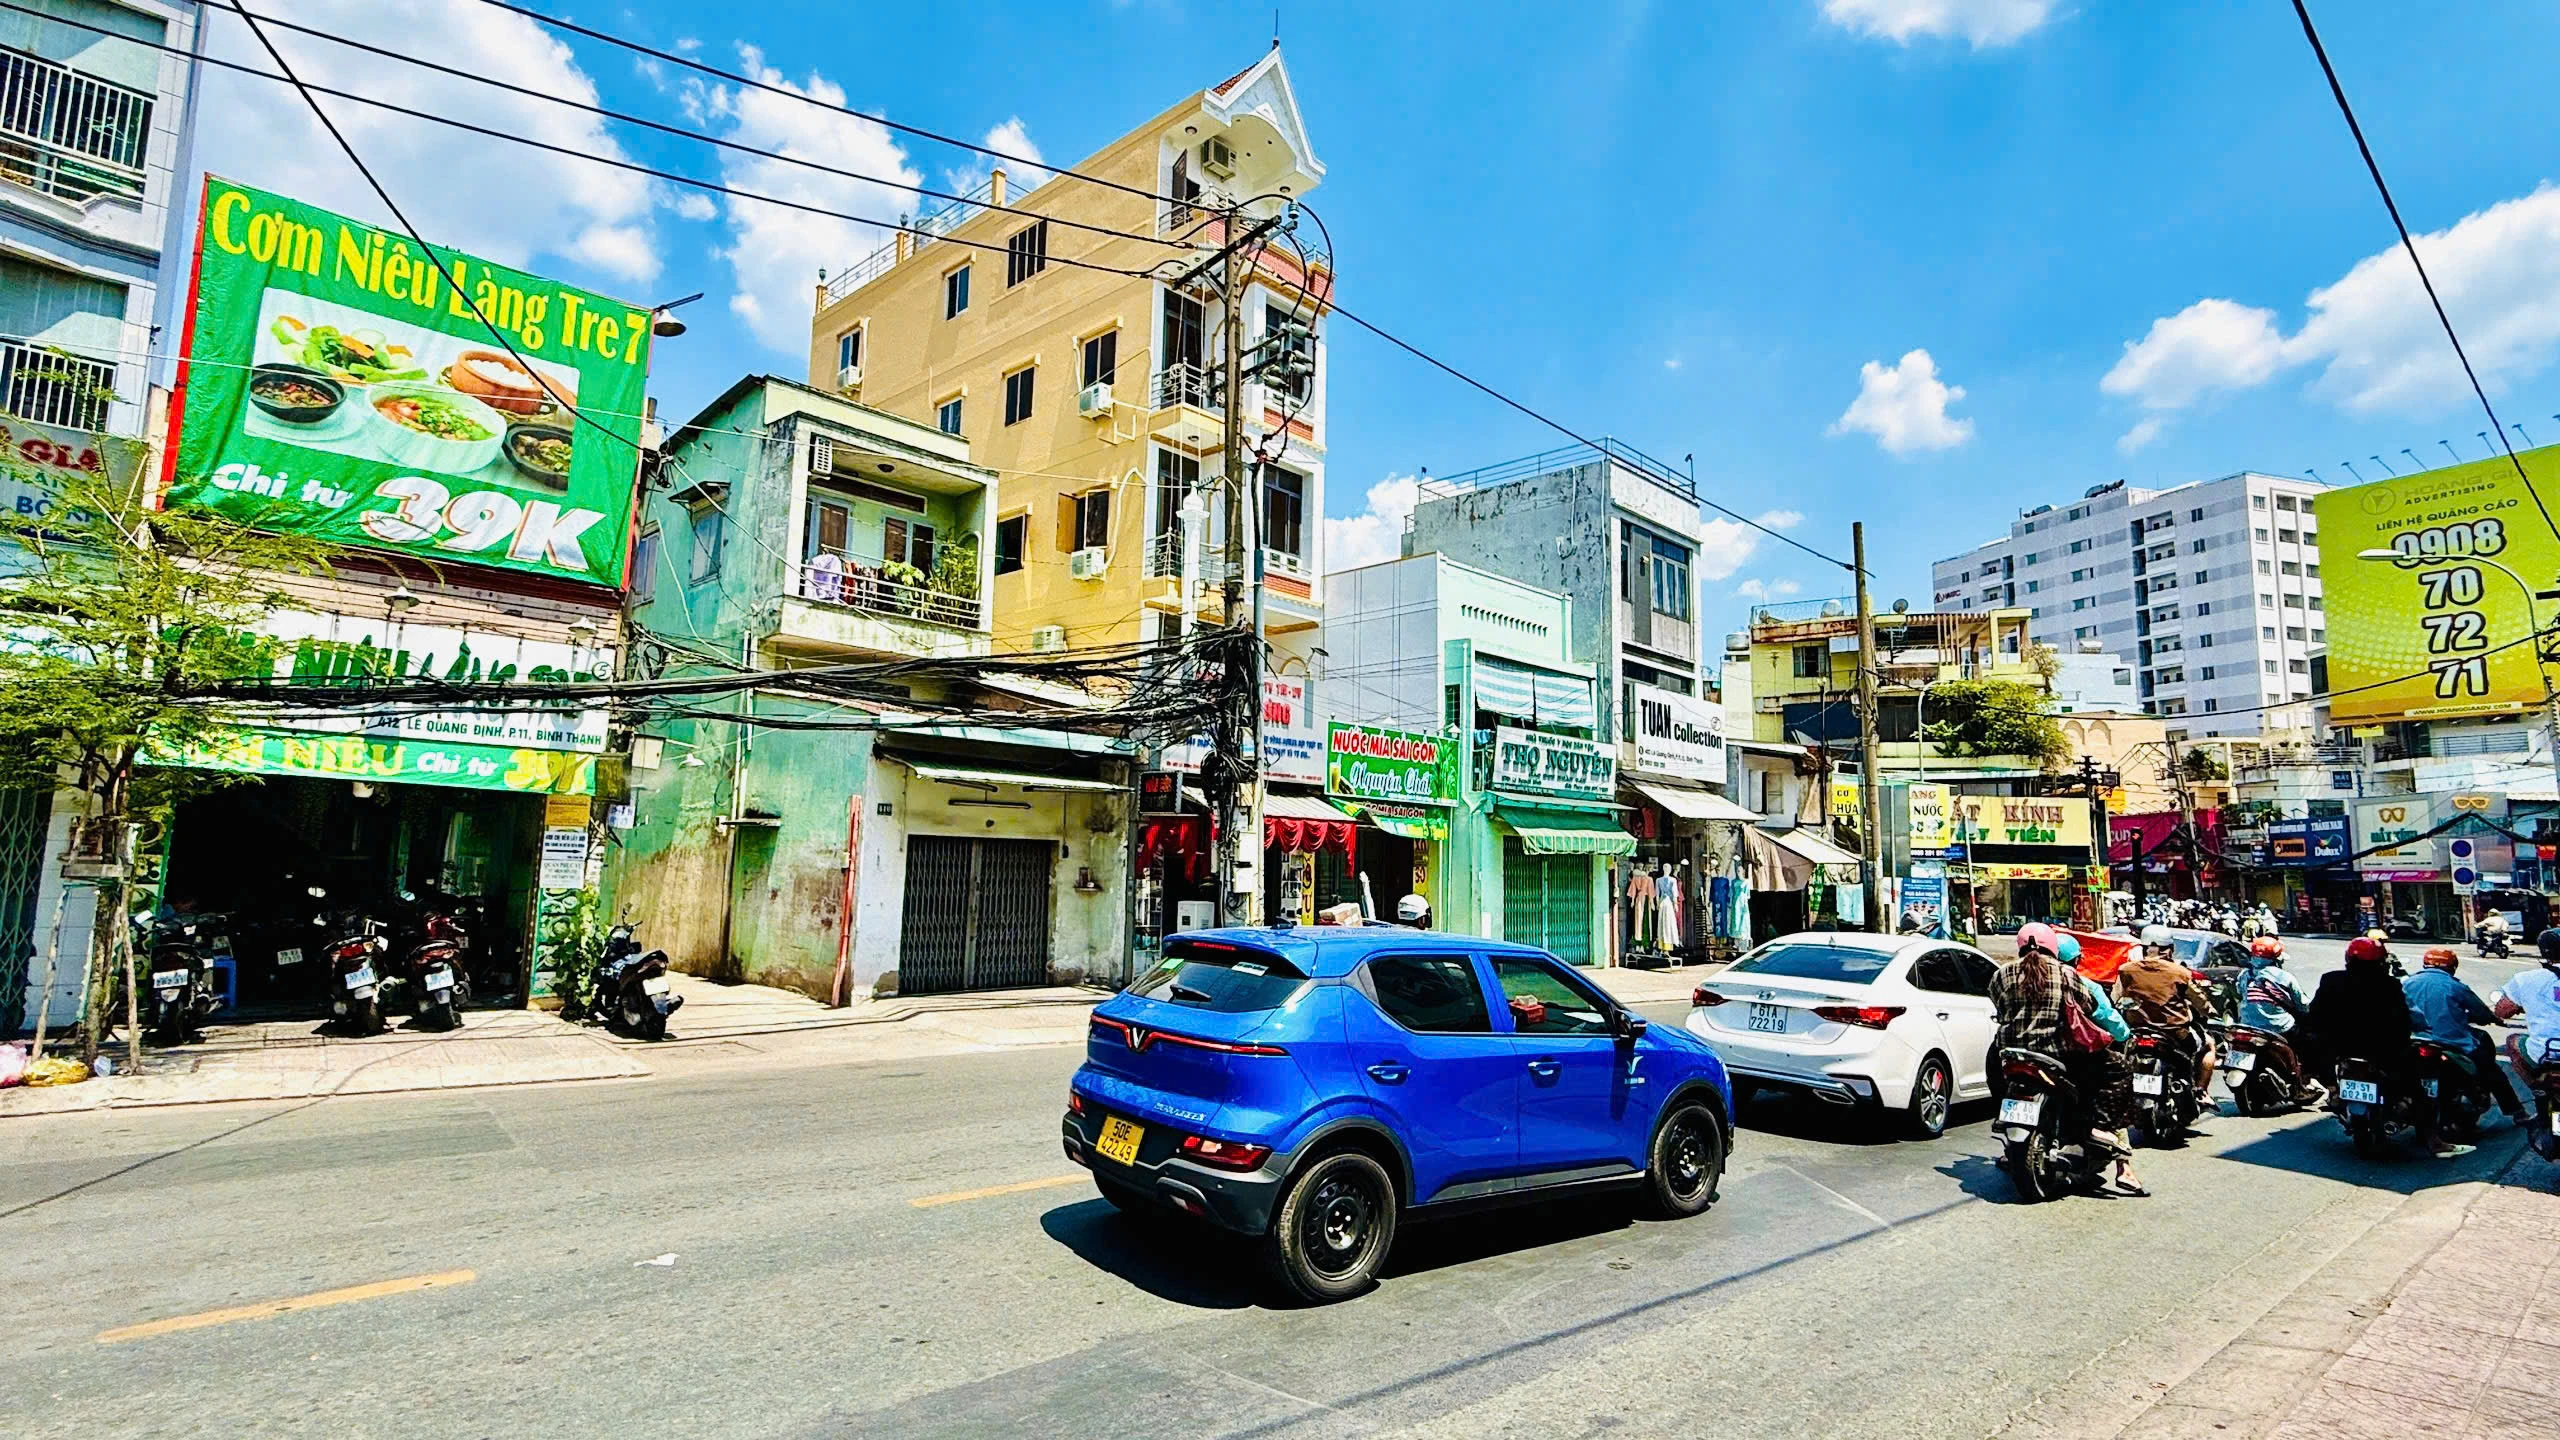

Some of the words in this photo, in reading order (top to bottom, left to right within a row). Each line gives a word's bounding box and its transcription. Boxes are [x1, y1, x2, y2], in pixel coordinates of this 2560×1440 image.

[212, 191, 323, 276] Cơm
[335, 225, 441, 309] Niêu
[449, 259, 549, 350] Làng
[2405, 483, 2496, 505] ADVERTISING
[360, 477, 607, 572] 39K
[2391, 517, 2507, 570] 0908
[2419, 567, 2483, 610] 70
[2421, 611, 2488, 654] 72
[2429, 656, 2489, 698] 71
[1641, 699, 1672, 740] TUAN
[1112, 1120, 1132, 1141] 50E
